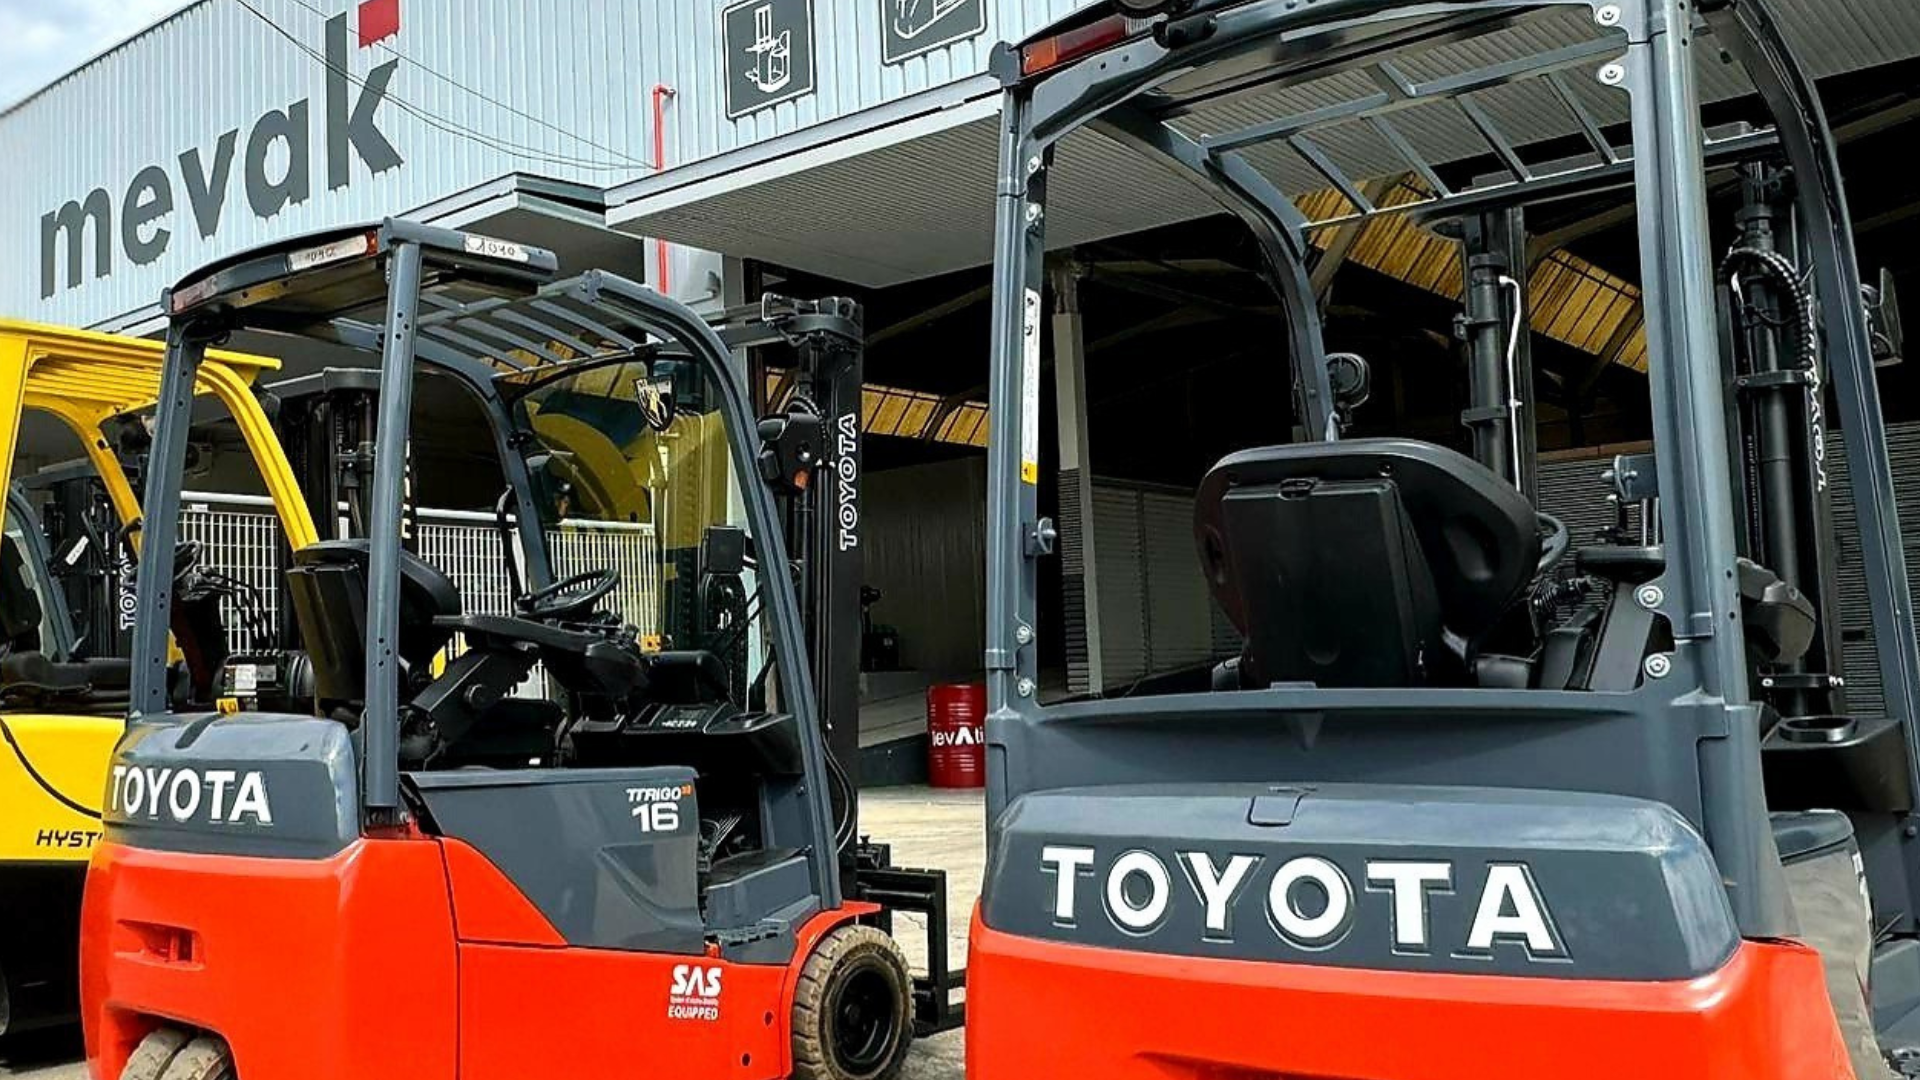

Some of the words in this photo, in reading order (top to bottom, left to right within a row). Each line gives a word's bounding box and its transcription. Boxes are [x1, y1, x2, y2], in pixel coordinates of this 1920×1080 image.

[41, 8, 404, 302] mevak
[838, 412, 858, 551] TOYOTA
[111, 765, 273, 825] TOYOTA
[631, 801, 679, 832] 16
[36, 829, 103, 848] HYST
[1041, 845, 1565, 956] TOYOTA
[671, 964, 722, 997] SAS
[668, 1004, 719, 1021] EQUIPPED
